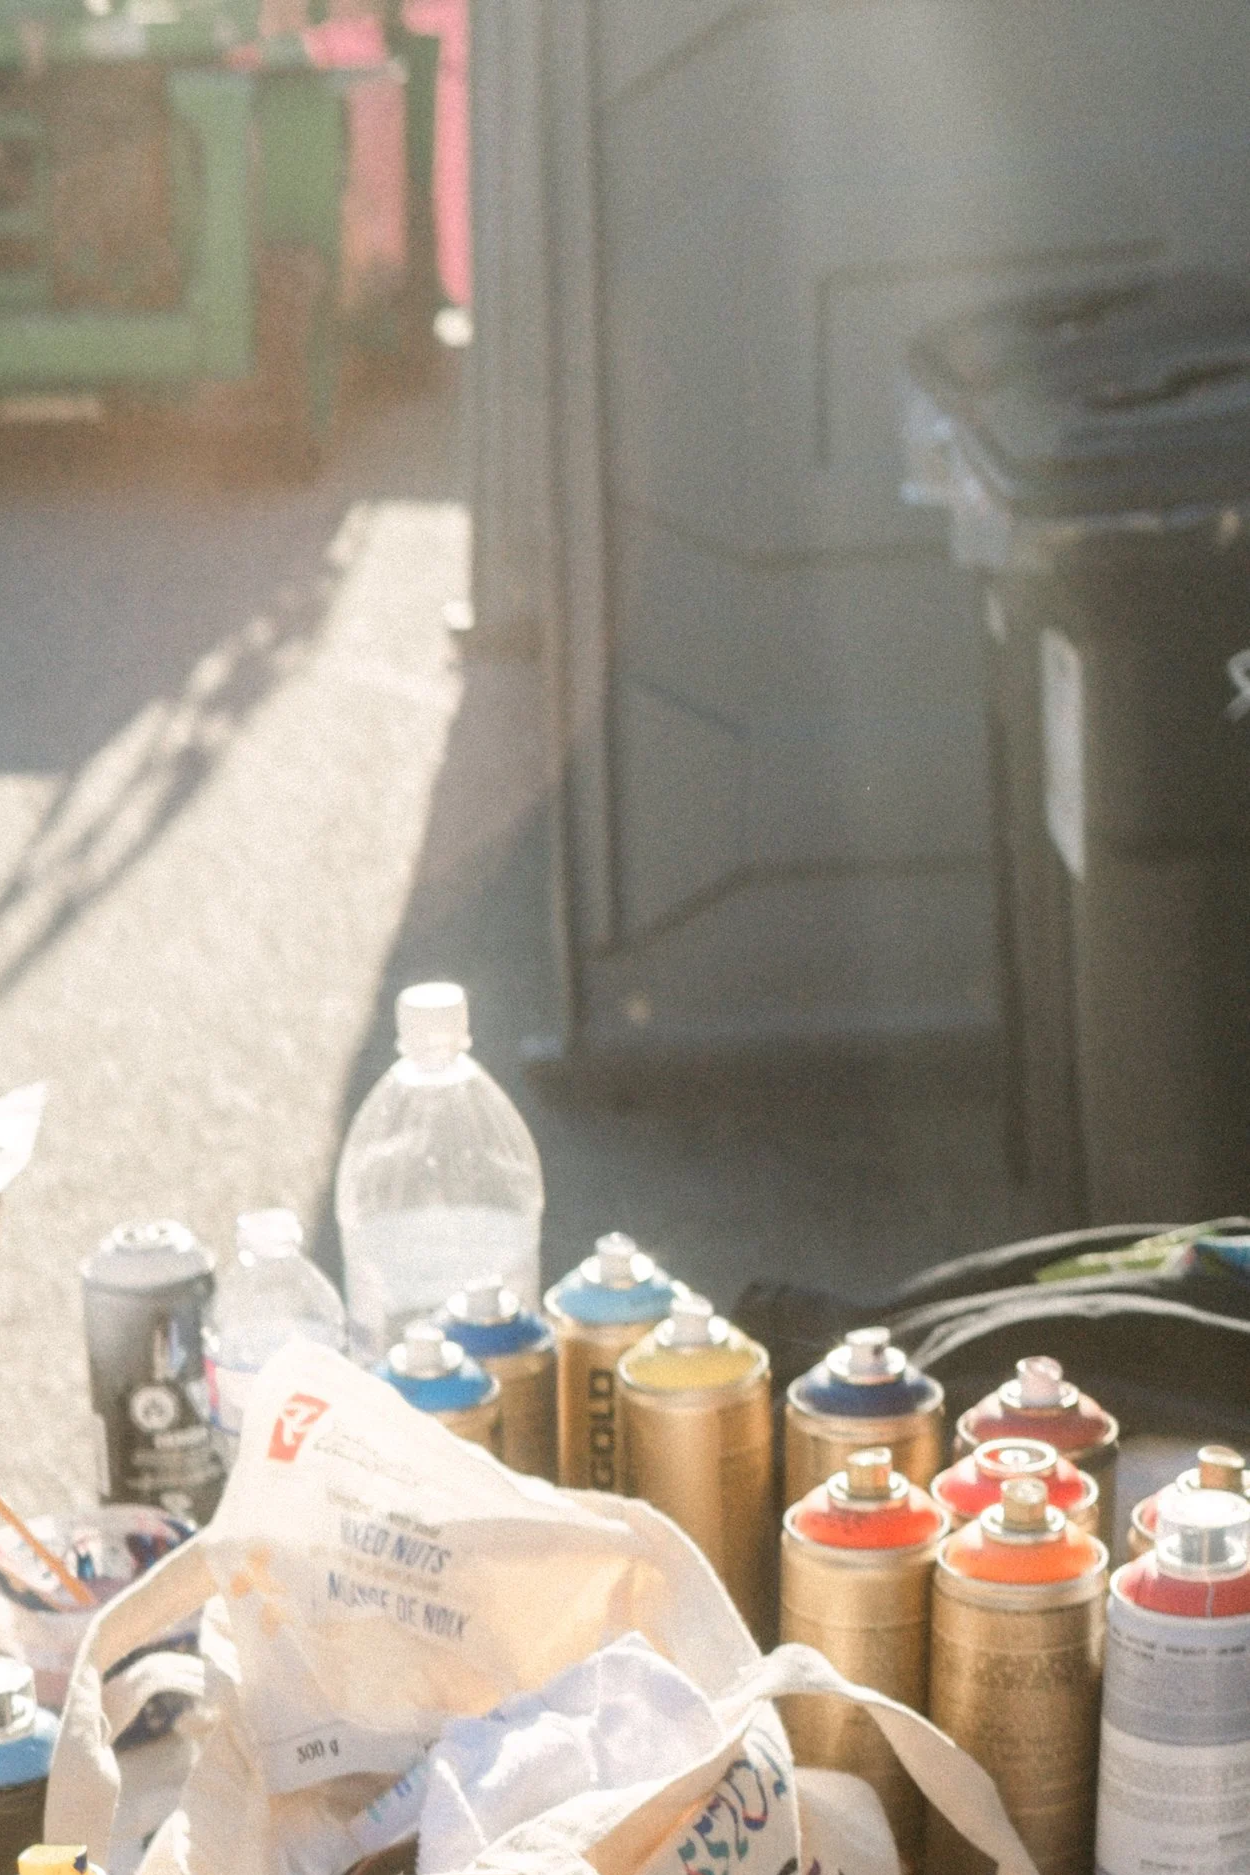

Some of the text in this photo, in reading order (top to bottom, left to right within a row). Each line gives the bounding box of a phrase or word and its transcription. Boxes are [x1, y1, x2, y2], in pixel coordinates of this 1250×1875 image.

[588, 1368, 616, 1491] GOLD
[391, 1534, 452, 1575] NUTS
[422, 1601, 472, 1642] NOIX
